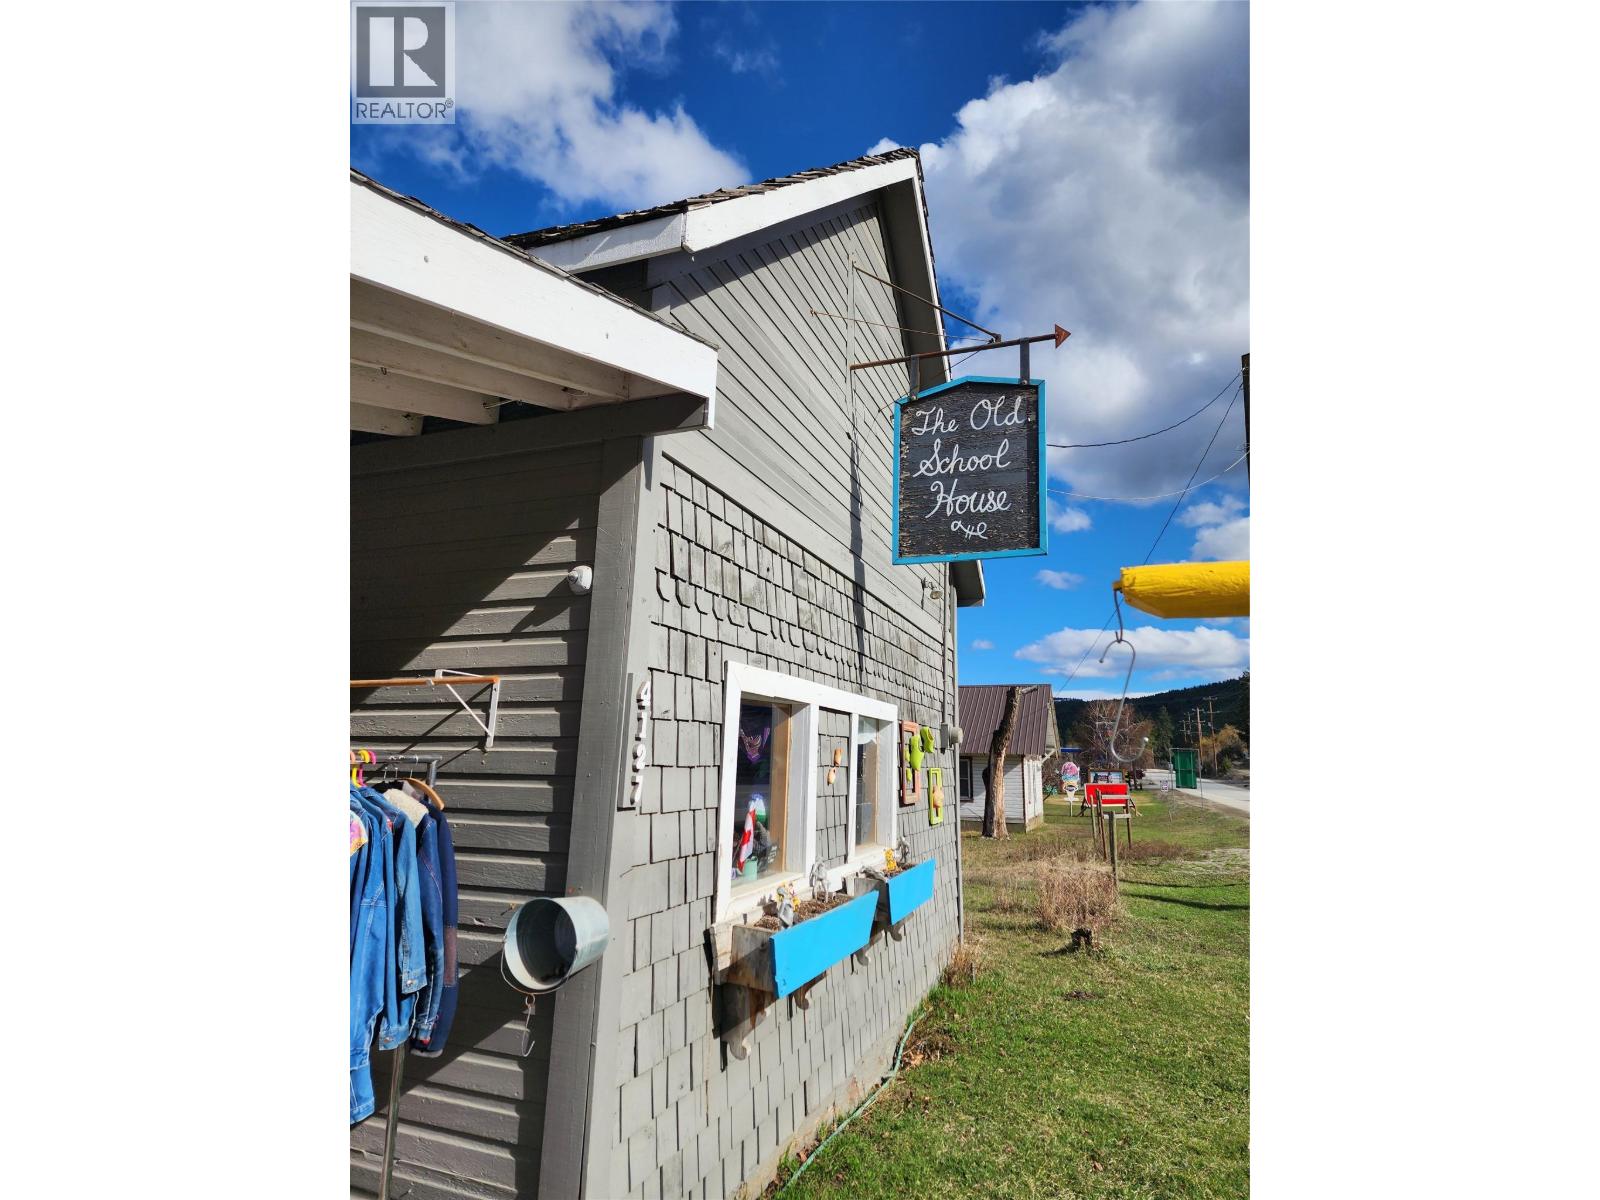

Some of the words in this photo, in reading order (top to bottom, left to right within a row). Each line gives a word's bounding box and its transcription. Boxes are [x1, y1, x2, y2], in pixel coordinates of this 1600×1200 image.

[911, 406, 959, 436] The
[970, 395, 1025, 431] Old
[912, 437, 1011, 478] School
[925, 478, 1011, 519] House
